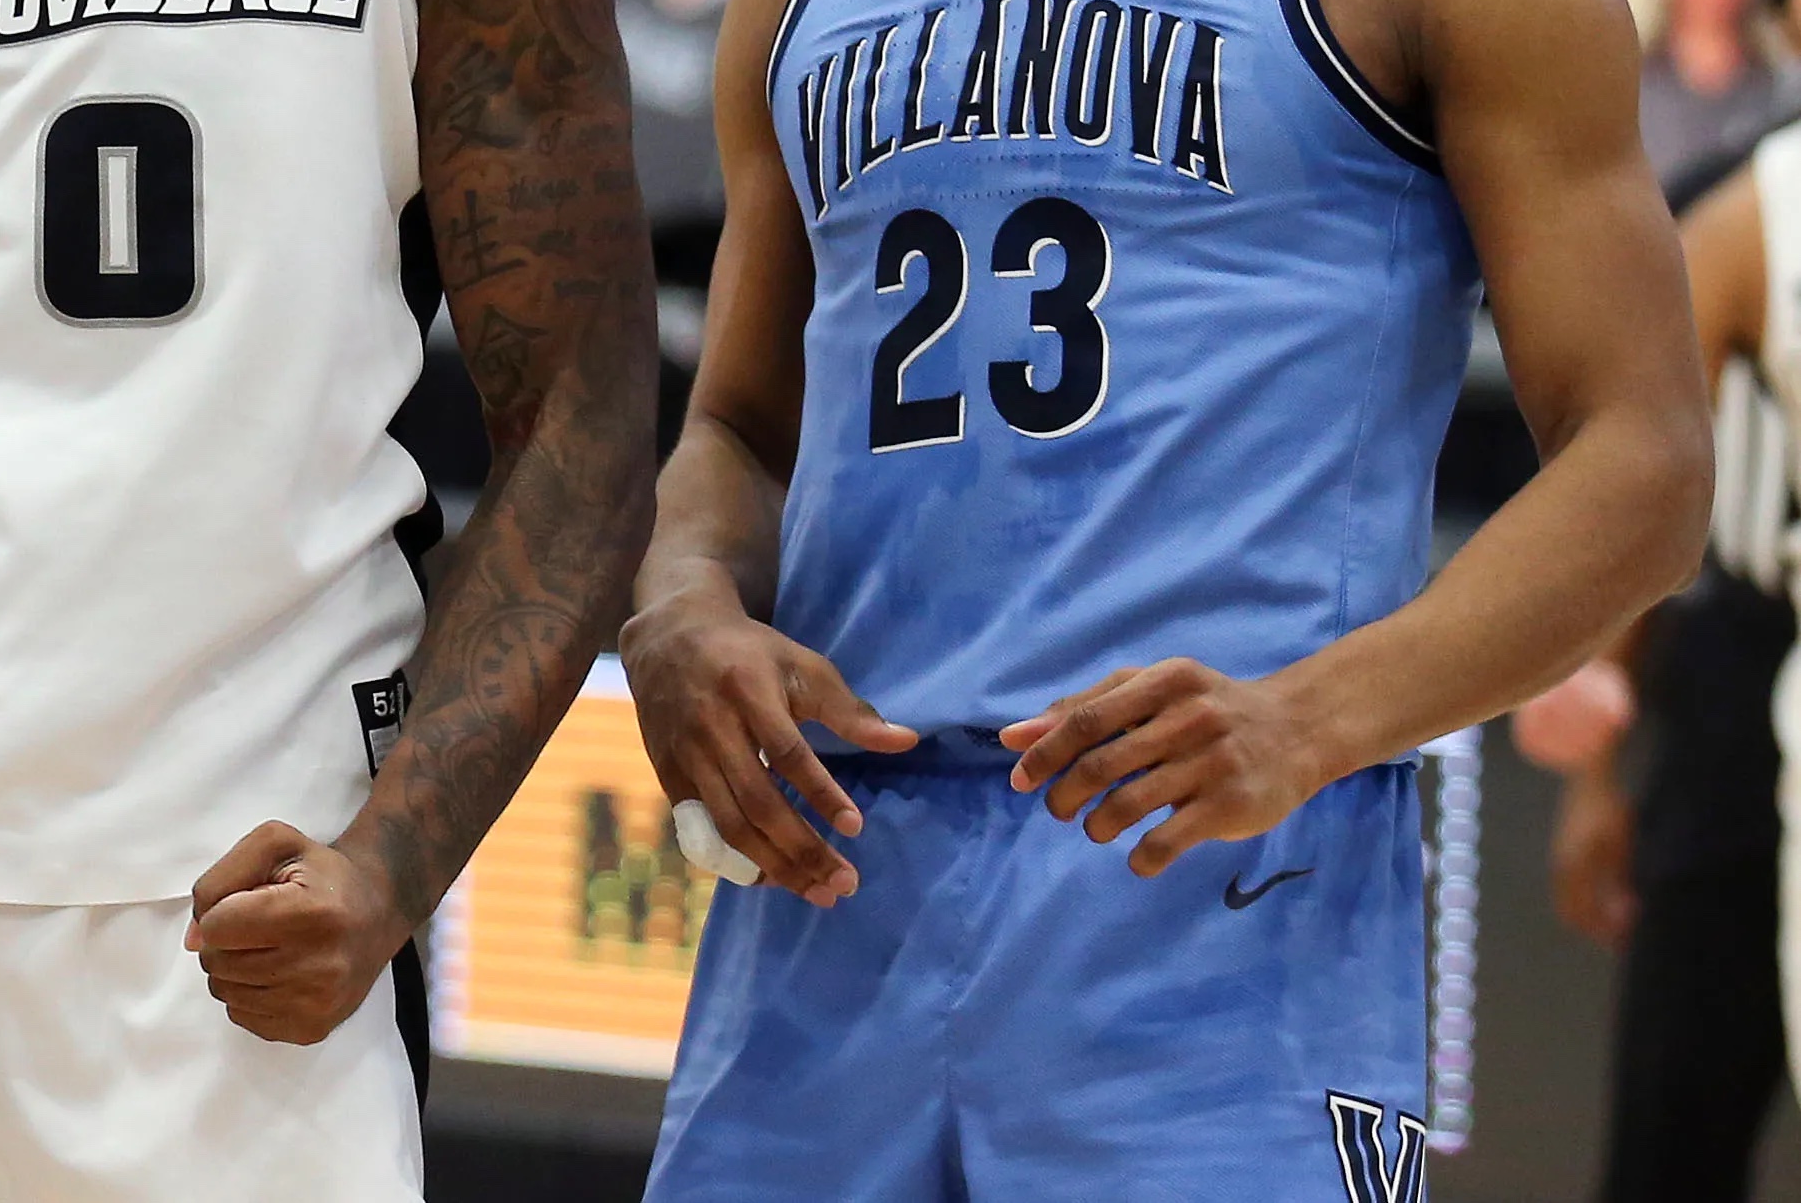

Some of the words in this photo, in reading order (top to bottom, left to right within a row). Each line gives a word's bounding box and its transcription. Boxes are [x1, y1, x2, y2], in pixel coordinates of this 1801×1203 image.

[35, 95, 205, 328] 0
[869, 196, 1112, 454] 23
[1325, 1088, 1427, 1203] V
